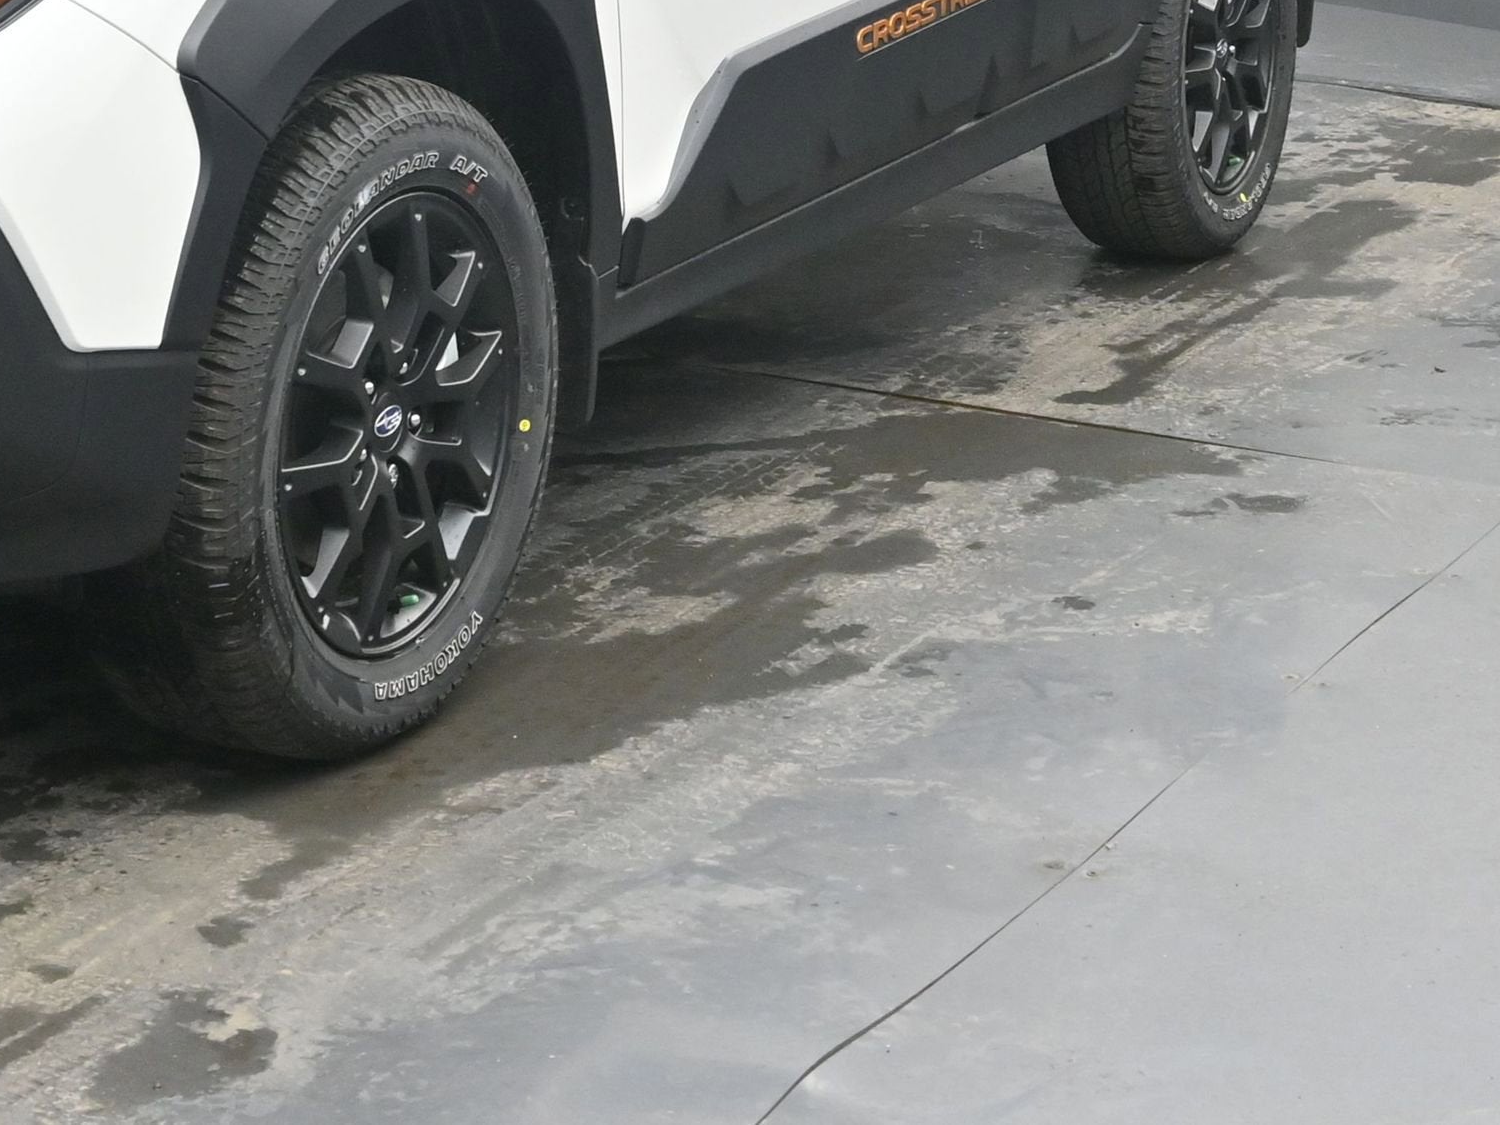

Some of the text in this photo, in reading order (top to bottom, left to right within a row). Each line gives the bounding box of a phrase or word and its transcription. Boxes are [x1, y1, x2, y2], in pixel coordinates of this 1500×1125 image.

[317, 151, 488, 275] GEOLANDAR A/T
[373, 611, 483, 701] YOKOHAMA
